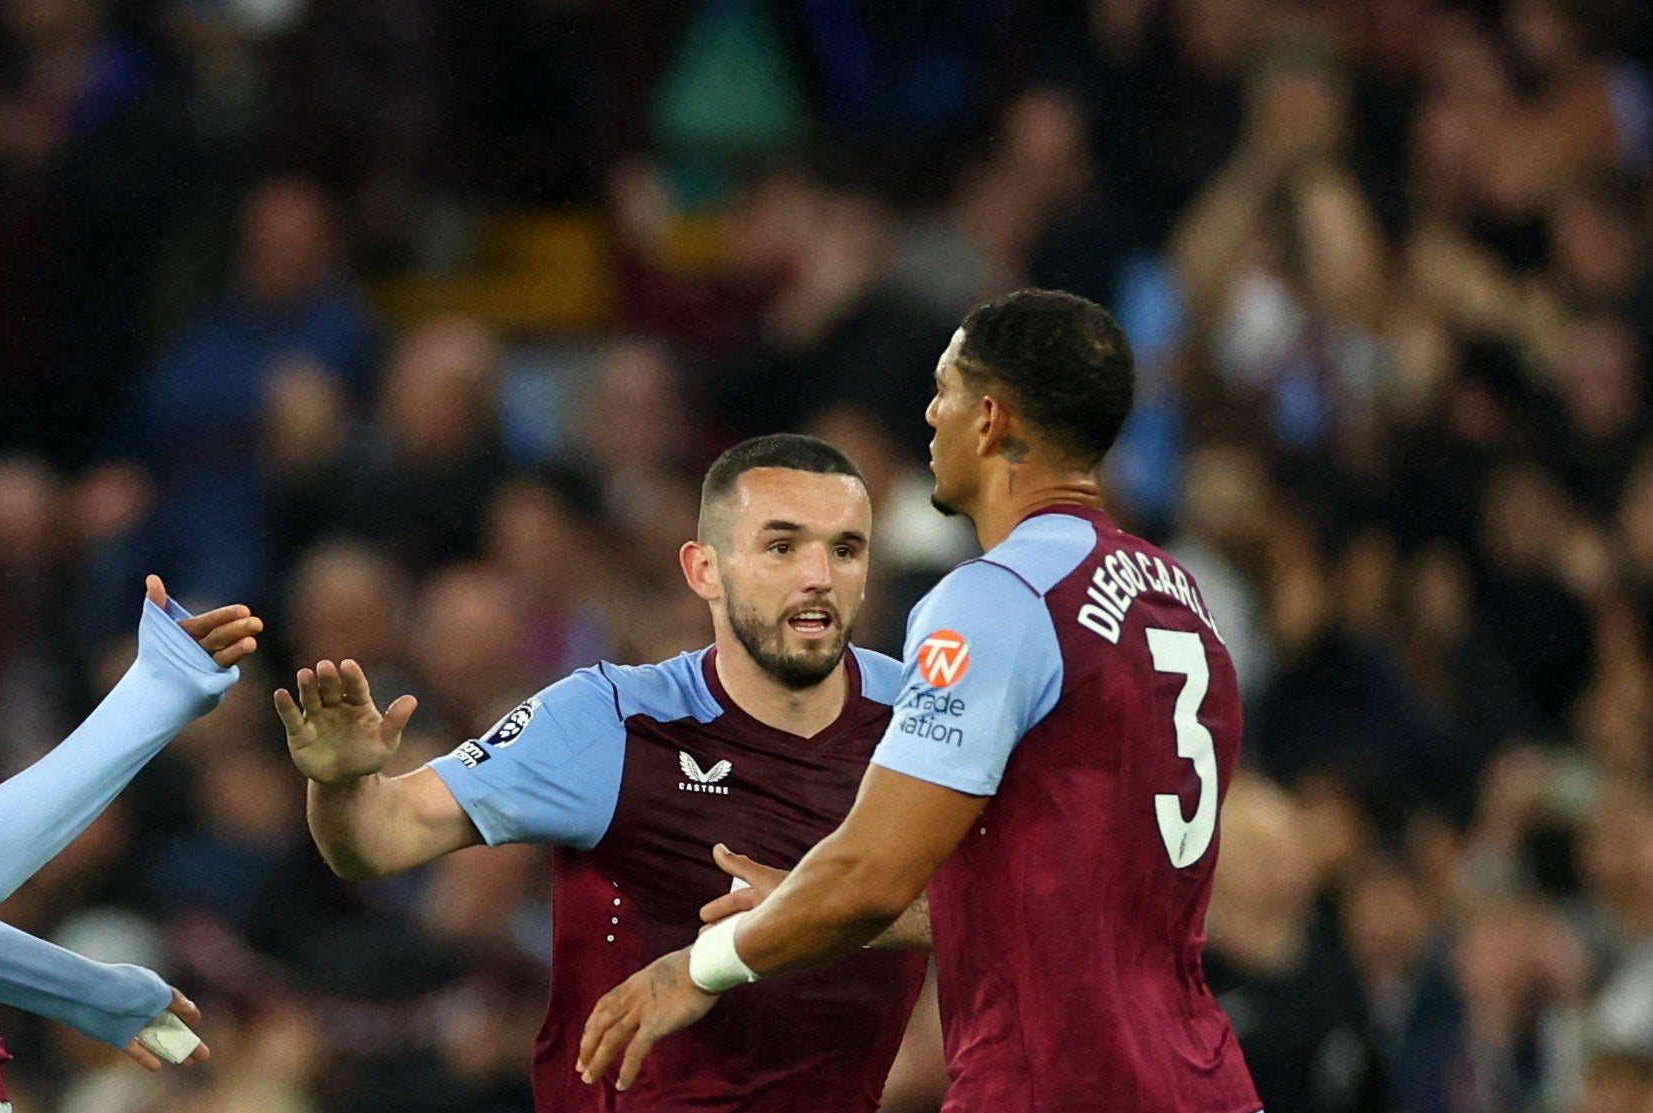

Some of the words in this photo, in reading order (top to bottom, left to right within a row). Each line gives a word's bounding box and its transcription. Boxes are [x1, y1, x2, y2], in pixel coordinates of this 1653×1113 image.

[1077, 549, 1147, 645] DIEGO
[1135, 551, 1226, 645] CARL
[678, 782, 730, 795] CASTORE
[1145, 627, 1219, 869] 3
